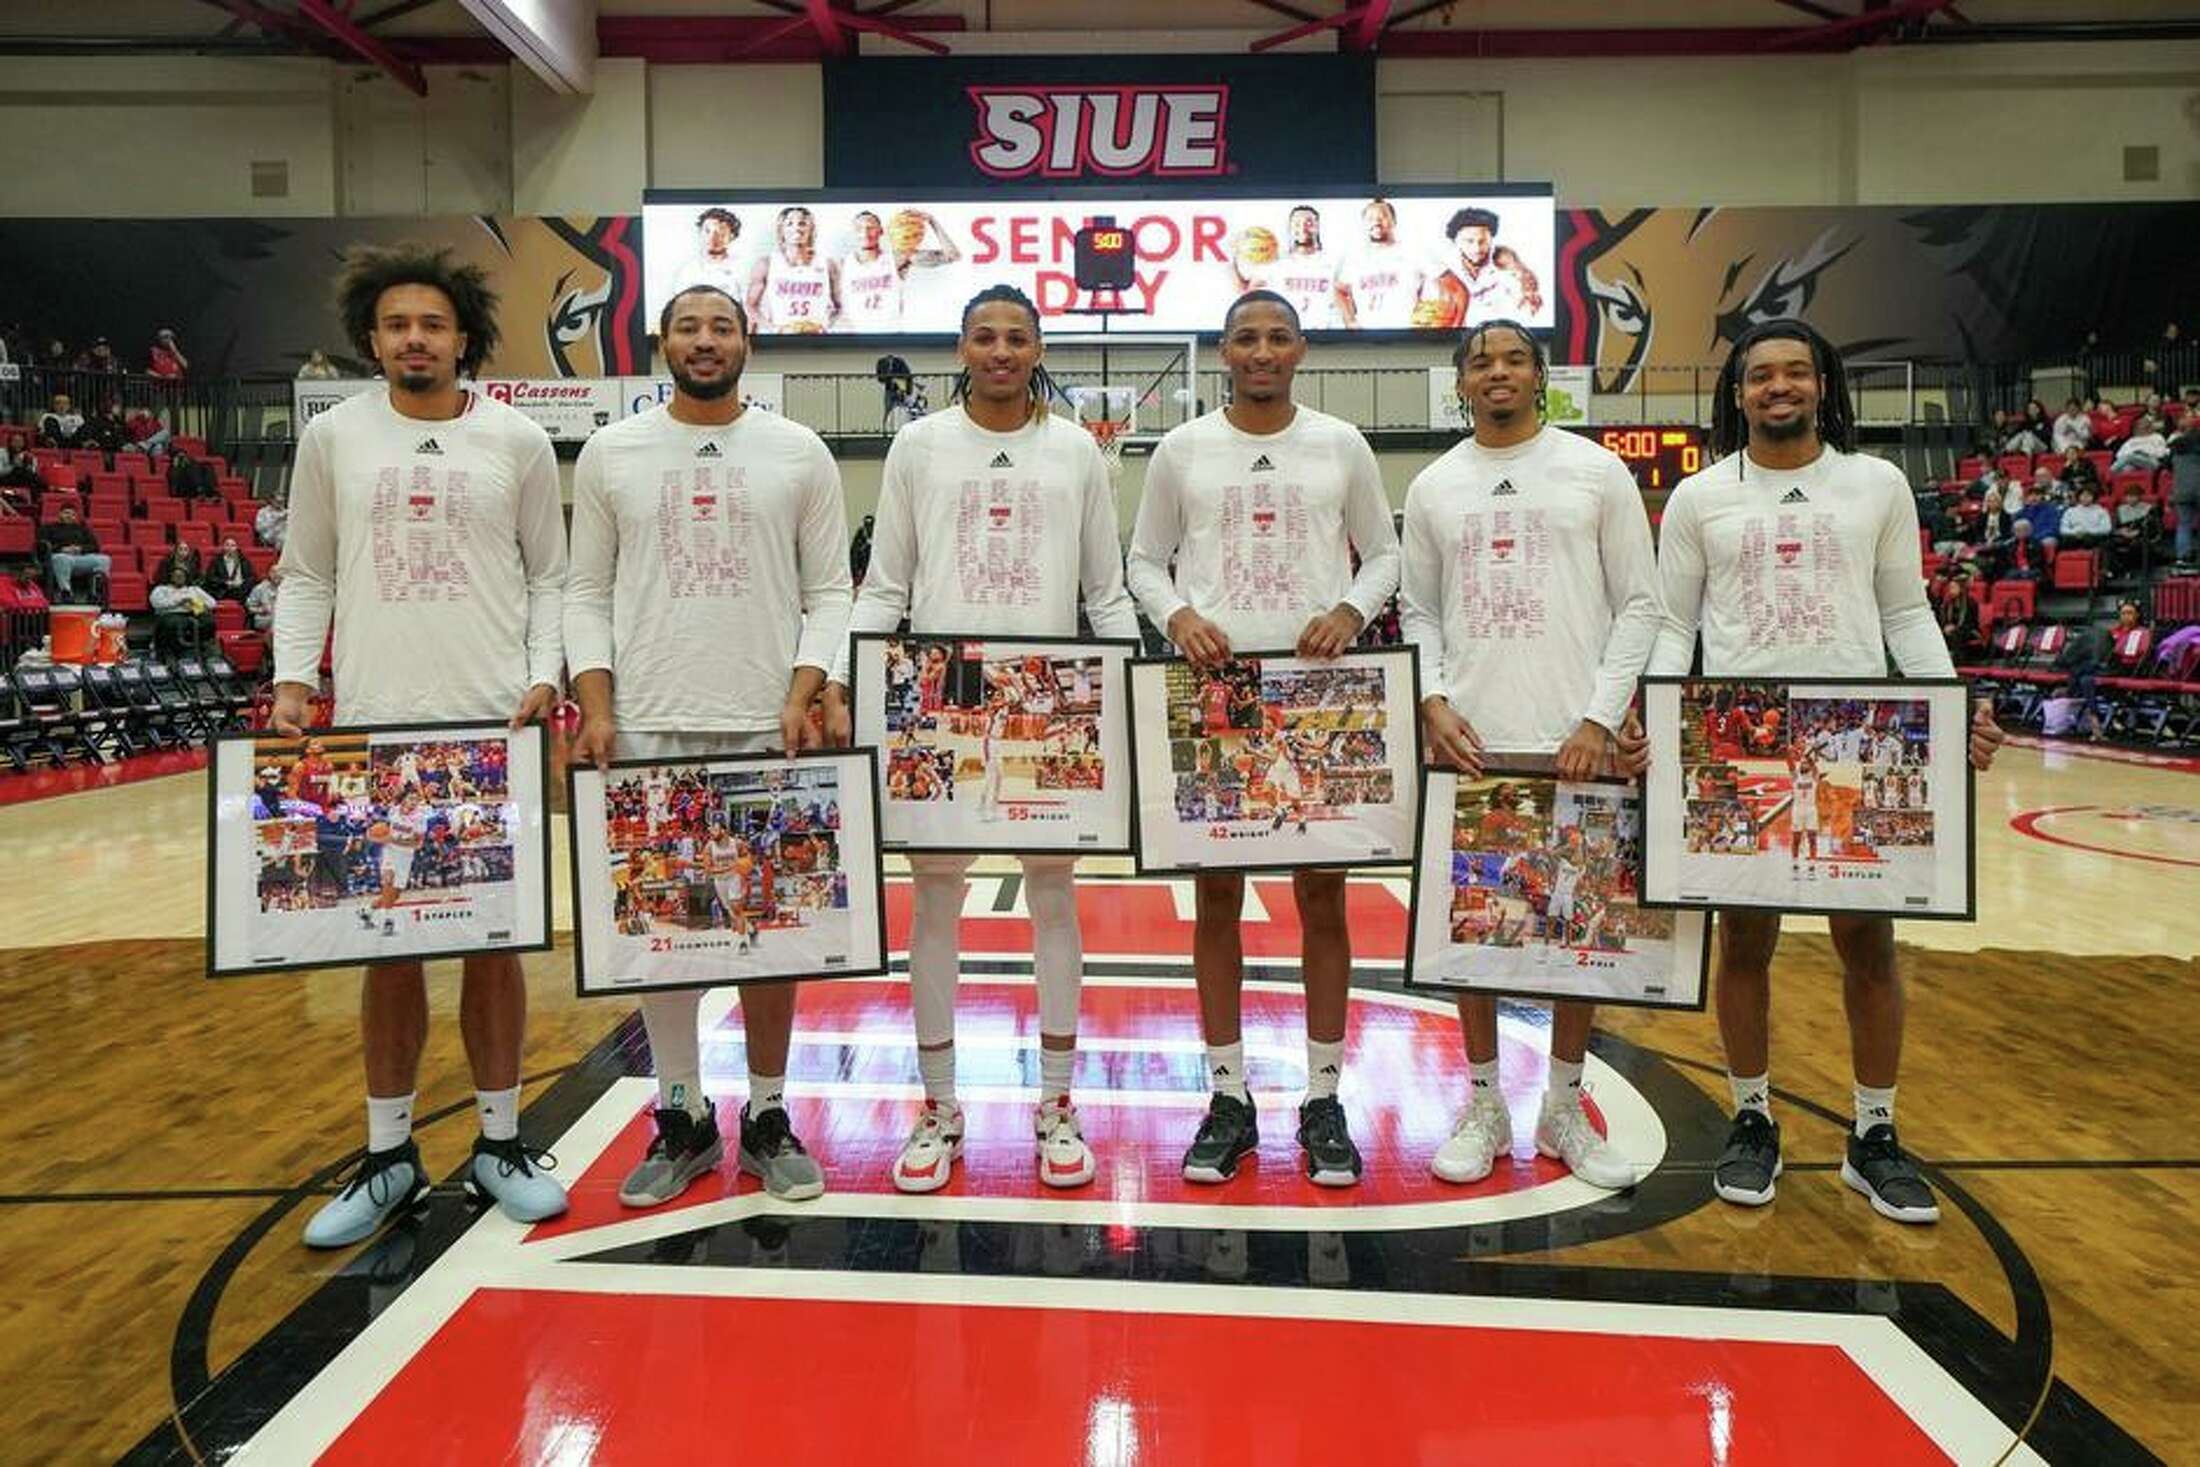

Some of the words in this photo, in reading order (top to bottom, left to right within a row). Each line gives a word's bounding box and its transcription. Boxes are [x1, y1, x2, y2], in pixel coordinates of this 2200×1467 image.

[969, 86, 1226, 174] SIUE
[513, 383, 592, 398] Cassens
[1603, 431, 1657, 457] 5:00
[1682, 446, 1700, 473] 0
[1008, 807, 1028, 821] 55
[1210, 826, 1228, 839] 42
[1828, 864, 1839, 879] 3
[651, 937, 672, 952] 21
[1577, 953, 1589, 966] 2
